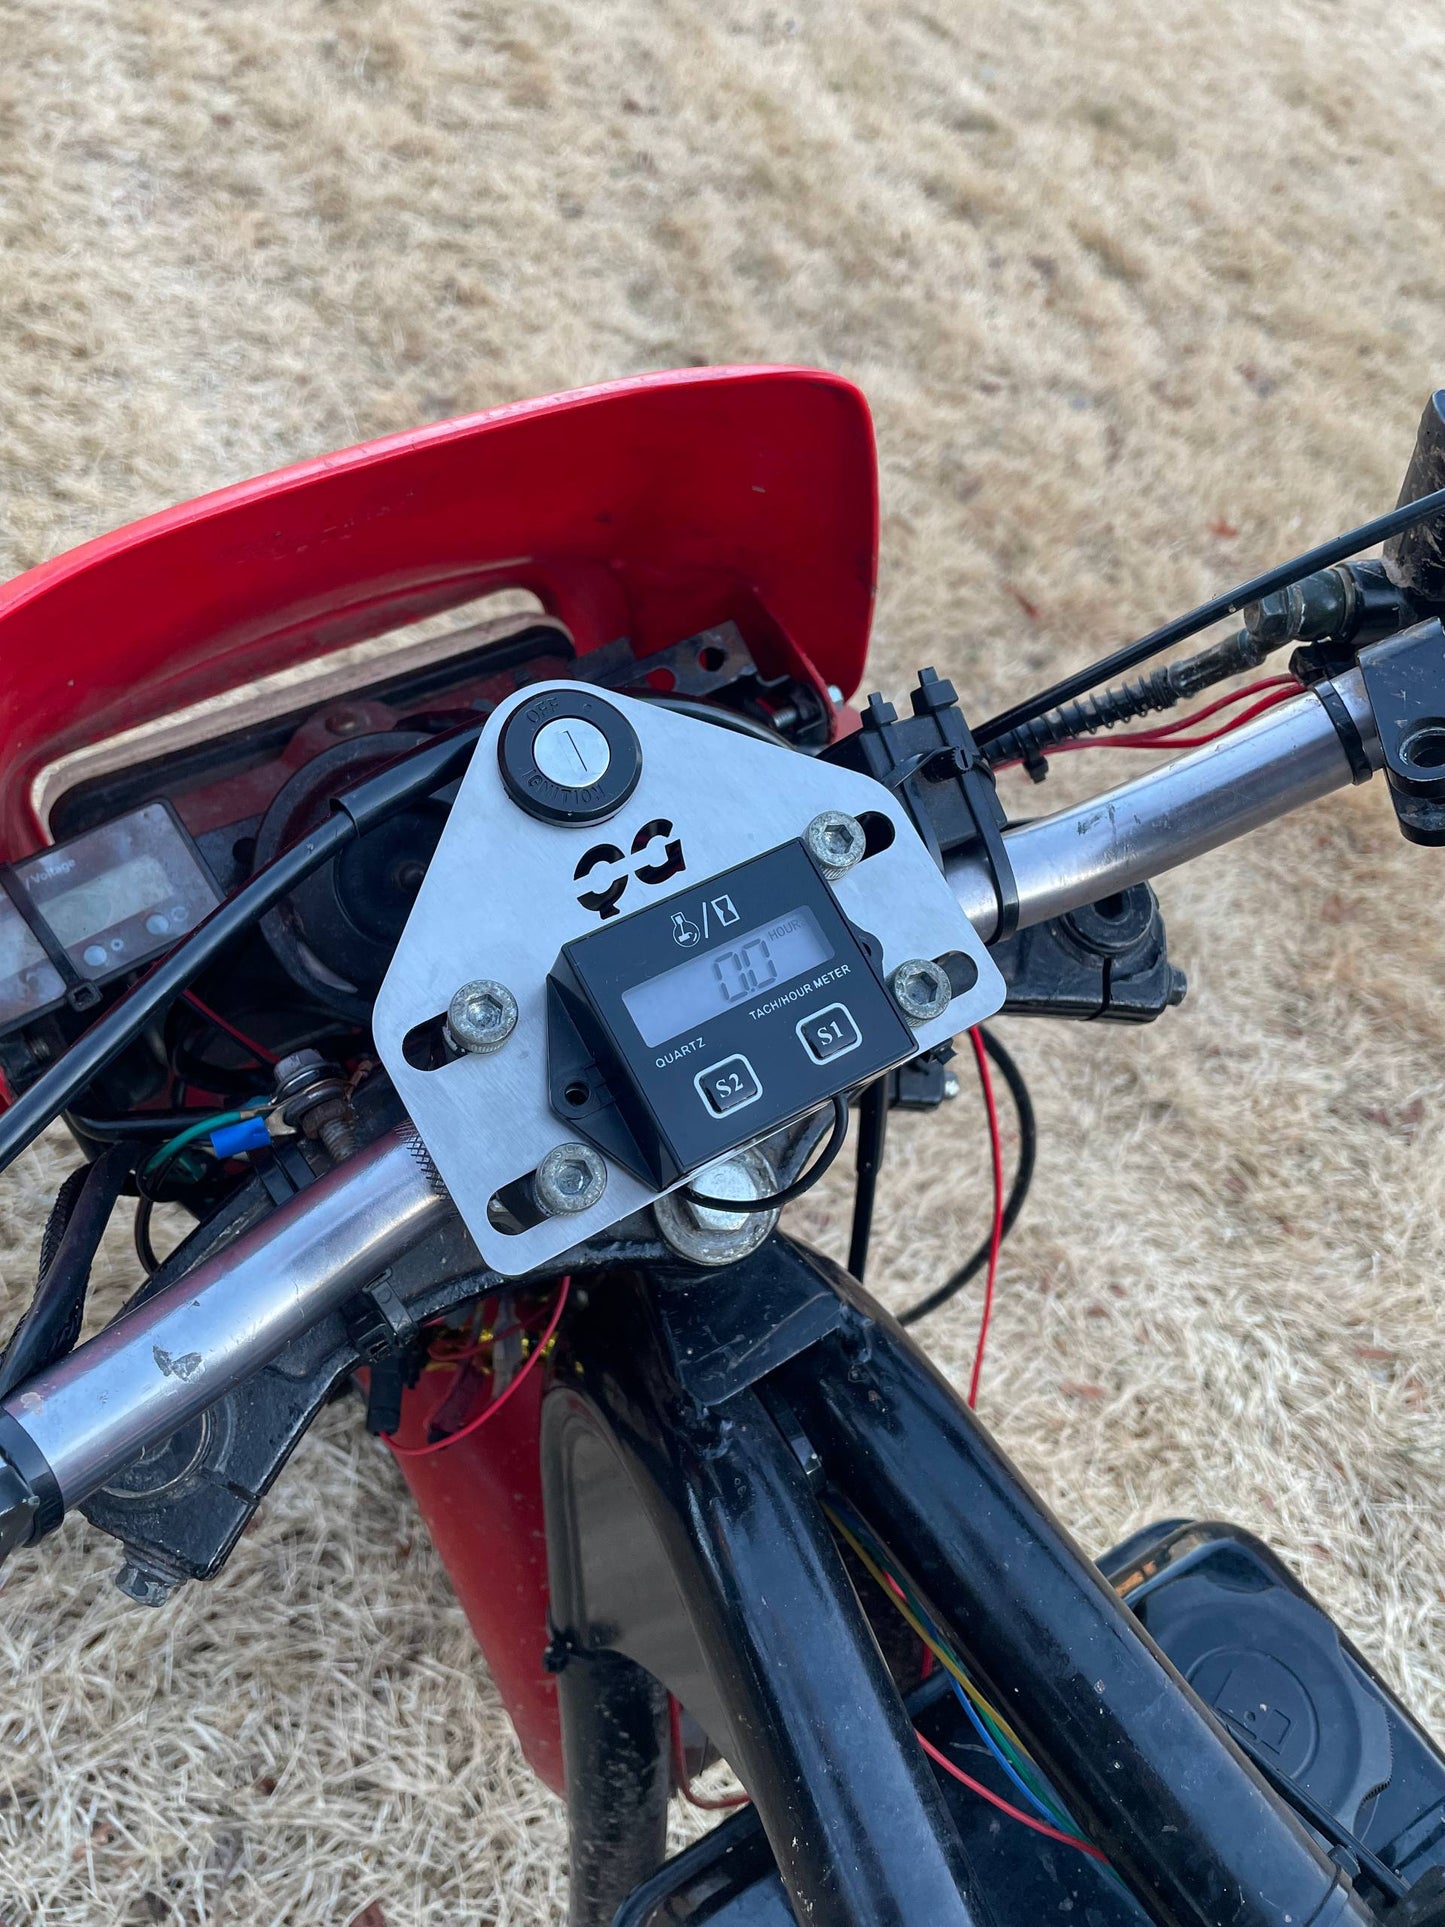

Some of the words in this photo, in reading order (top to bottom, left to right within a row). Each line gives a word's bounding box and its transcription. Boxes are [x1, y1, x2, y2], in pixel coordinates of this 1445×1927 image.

[526, 697, 559, 723] OFF
[522, 768, 606, 805] IGNITION
[749, 983, 813, 1020] TACH/HOUR
[813, 964, 851, 988] METER
[817, 1021, 843, 1045] S1
[655, 1037, 706, 1068] QUARTZ
[715, 1073, 744, 1098] S2
